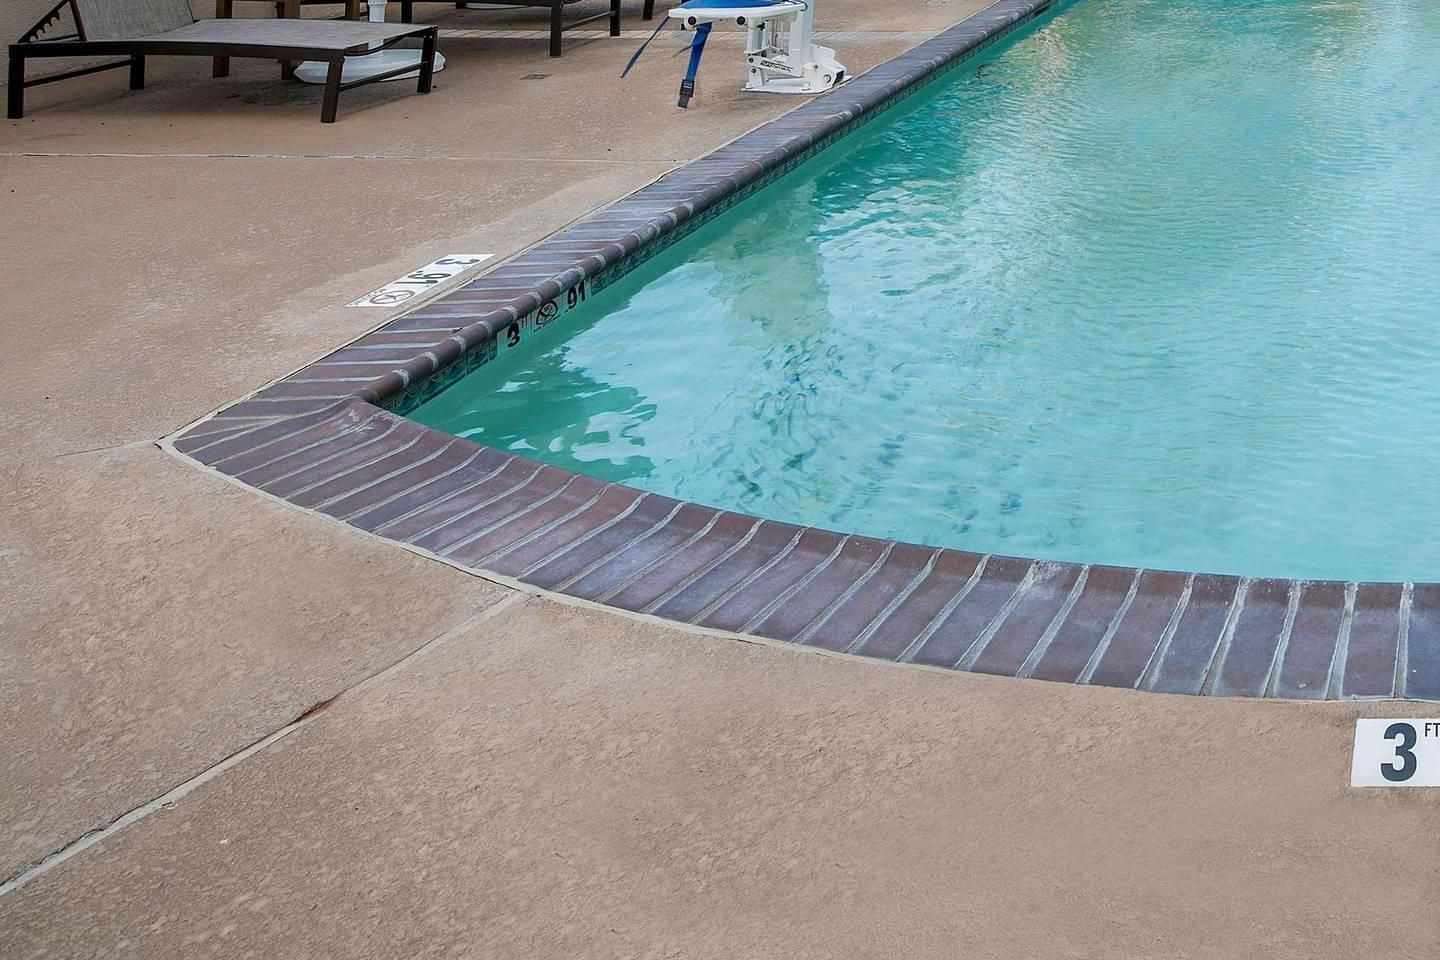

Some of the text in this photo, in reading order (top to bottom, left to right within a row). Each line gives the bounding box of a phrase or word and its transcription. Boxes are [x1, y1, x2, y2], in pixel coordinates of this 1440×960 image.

[507, 322, 520, 347] 3
[1380, 722, 1440, 782] 3 FT
